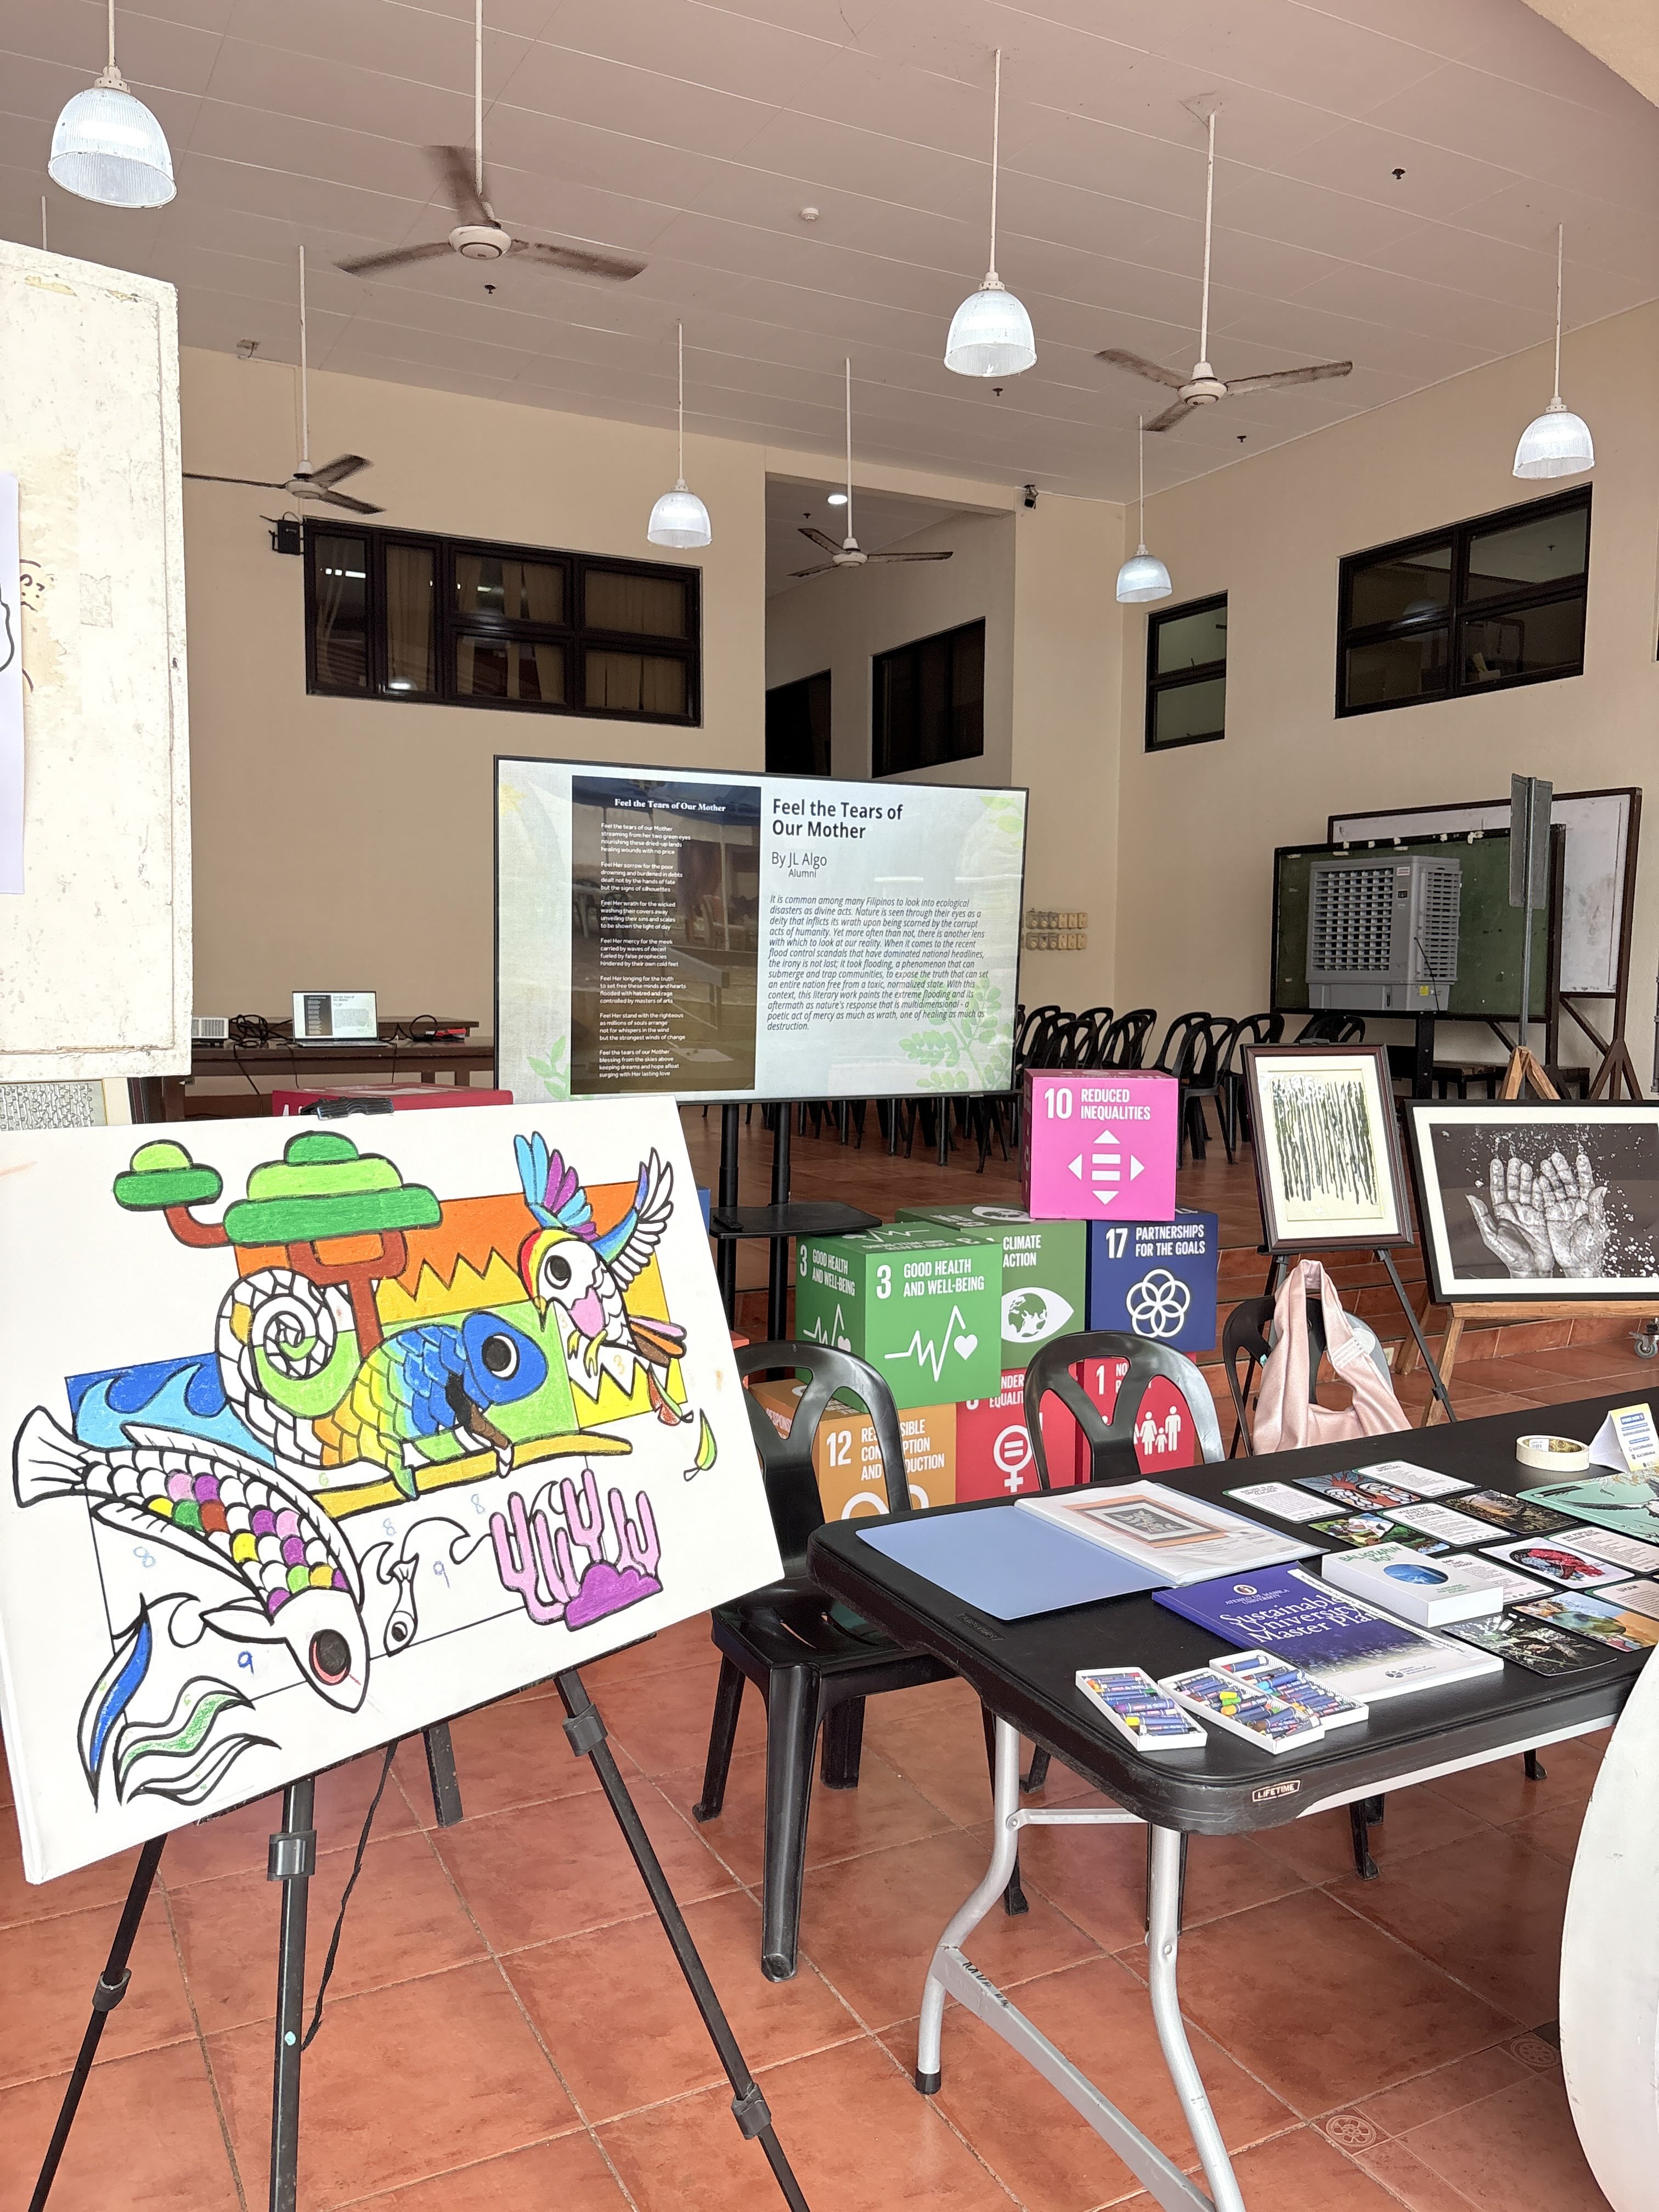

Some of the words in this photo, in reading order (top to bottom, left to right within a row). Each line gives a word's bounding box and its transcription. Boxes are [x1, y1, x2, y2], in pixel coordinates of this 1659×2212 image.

[647, 800, 669, 809] Tears
[698, 803, 726, 811] Mother
[774, 799, 805, 815] Feel
[810, 800, 836, 817] the
[840, 802, 883, 819] Tears
[887, 804, 903, 820] of
[772, 820, 803, 836] Our
[808, 821, 866, 838] Mother
[772, 852, 786, 868] By
[788, 853, 799, 868] JL
[802, 853, 827, 869] Algo
[788, 868, 816, 878] Alumni
[770, 895, 776, 904] It
[777, 895, 783, 904] is
[819, 898, 843, 907] among
[845, 898, 865, 907] many
[866, 897, 895, 908] Filipinos
[905, 898, 919, 906] look
[921, 899, 934, 907] into
[936, 899, 969, 909] ecological
[770, 906, 802, 915] disasters
[815, 906, 835, 915] divine
[838, 907, 853, 916] acts.
[855, 907, 879, 916] Nature
[906, 909, 932, 919] through
[934, 909, 950, 917] their
[952, 911, 966, 919] eyes
[770, 916, 788, 927] deity
[789, 917, 804, 926] that
[806, 917, 828, 928] inflicts
[864, 919, 881, 928] upon
[883, 919, 901, 929] being
[904, 919, 930, 927] scorned
[932, 919, 940, 929] by
[953, 921, 978, 929] corrupt
[770, 928, 785, 936] acts
[786, 927, 794, 938] of
[795, 928, 831, 939] humanity.
[833, 928, 844, 936] Yet
[866, 928, 883, 939] often
[902, 930, 915, 938] not,
[918, 929, 935, 938] there
[971, 930, 985, 938] lens
[1045, 1088, 1073, 1119] 10
[1081, 1088, 1130, 1103] REDUCED
[1081, 1105, 1150, 1121] INEQUALITIES
[1003, 1235, 1041, 1250] CLIMATE
[1106, 1228, 1128, 1259] 17
[1136, 1224, 1204, 1240] PARTNERSHIPS
[1135, 1243, 1153, 1257] FOR
[1156, 1242, 1172, 1256] THE
[1176, 1240, 1205, 1255] GOALS
[800, 1244, 807, 1276] 3
[812, 1249, 827, 1267] GOOD
[828, 1254, 848, 1274] HEALTH
[1003, 1252, 1036, 1268] ACTION
[812, 1267, 823, 1284] AND
[824, 1271, 855, 1296] WELL-BEING
[877, 1265, 891, 1299] 3
[904, 1262, 932, 1278] GOOD
[935, 1259, 971, 1276] HEALTH
[903, 1281, 924, 1297] AND
[927, 1276, 984, 1295] WELL-BEING
[1001, 1374, 1024, 1390] NDER
[1096, 1364, 1105, 1395] 1
[1116, 1363, 1128, 1376] NO
[827, 1430, 851, 1467] 12
[861, 1464, 882, 1481] AND
[1339, 1545, 1402, 1562] BALIGTARIN
[1225, 1596, 1251, 1605] ATENEO
[1242, 1594, 1281, 1605] UNIVERSITY
[1220, 1594, 1344, 1625] Sustainable
[1238, 1605, 1362, 1633] University
[1247, 1622, 1332, 1643] Master
[1258, 1784, 1295, 1798] LIFETIME
